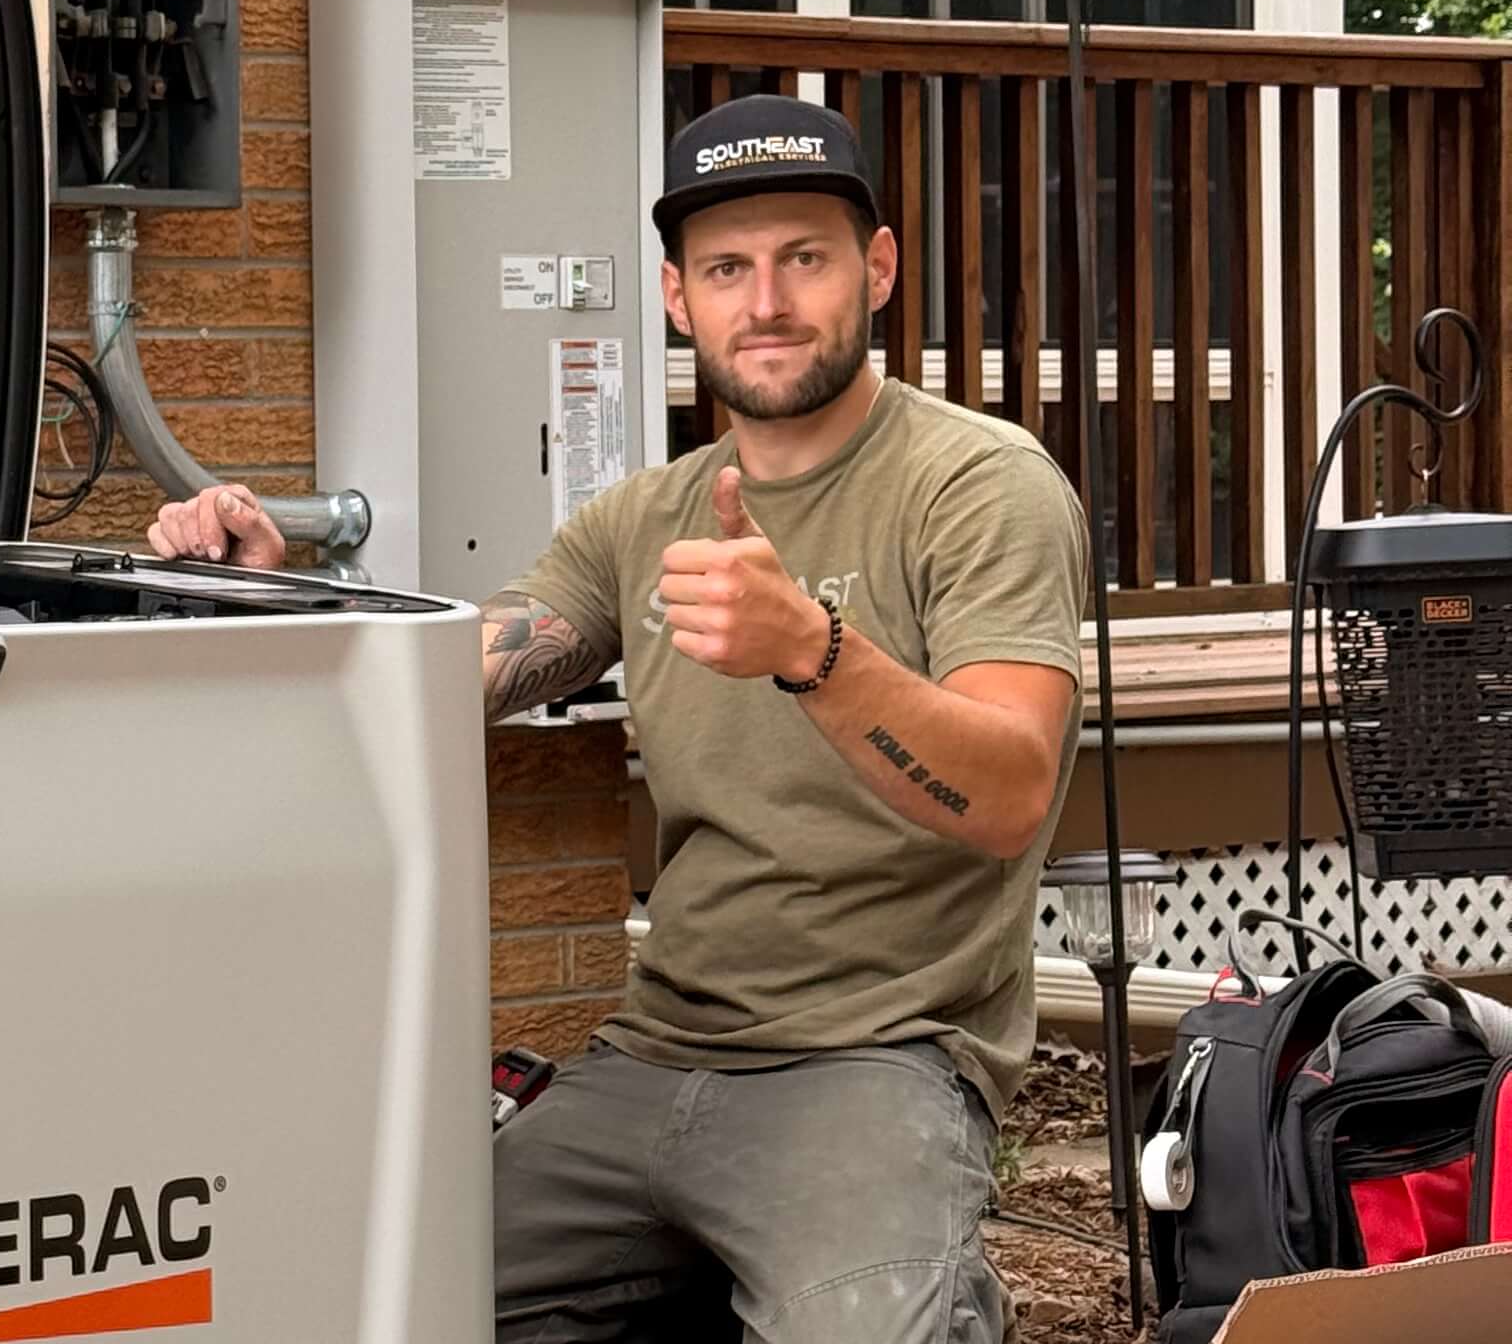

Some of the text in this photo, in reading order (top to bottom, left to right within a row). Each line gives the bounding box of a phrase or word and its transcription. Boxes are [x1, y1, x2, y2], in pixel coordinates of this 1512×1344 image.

[696, 136, 824, 174] SOUTHEAST
[538, 261, 554, 273] ON
[534, 293, 553, 305] OFF
[864, 725, 915, 770] HOME
[907, 764, 930, 784] IS
